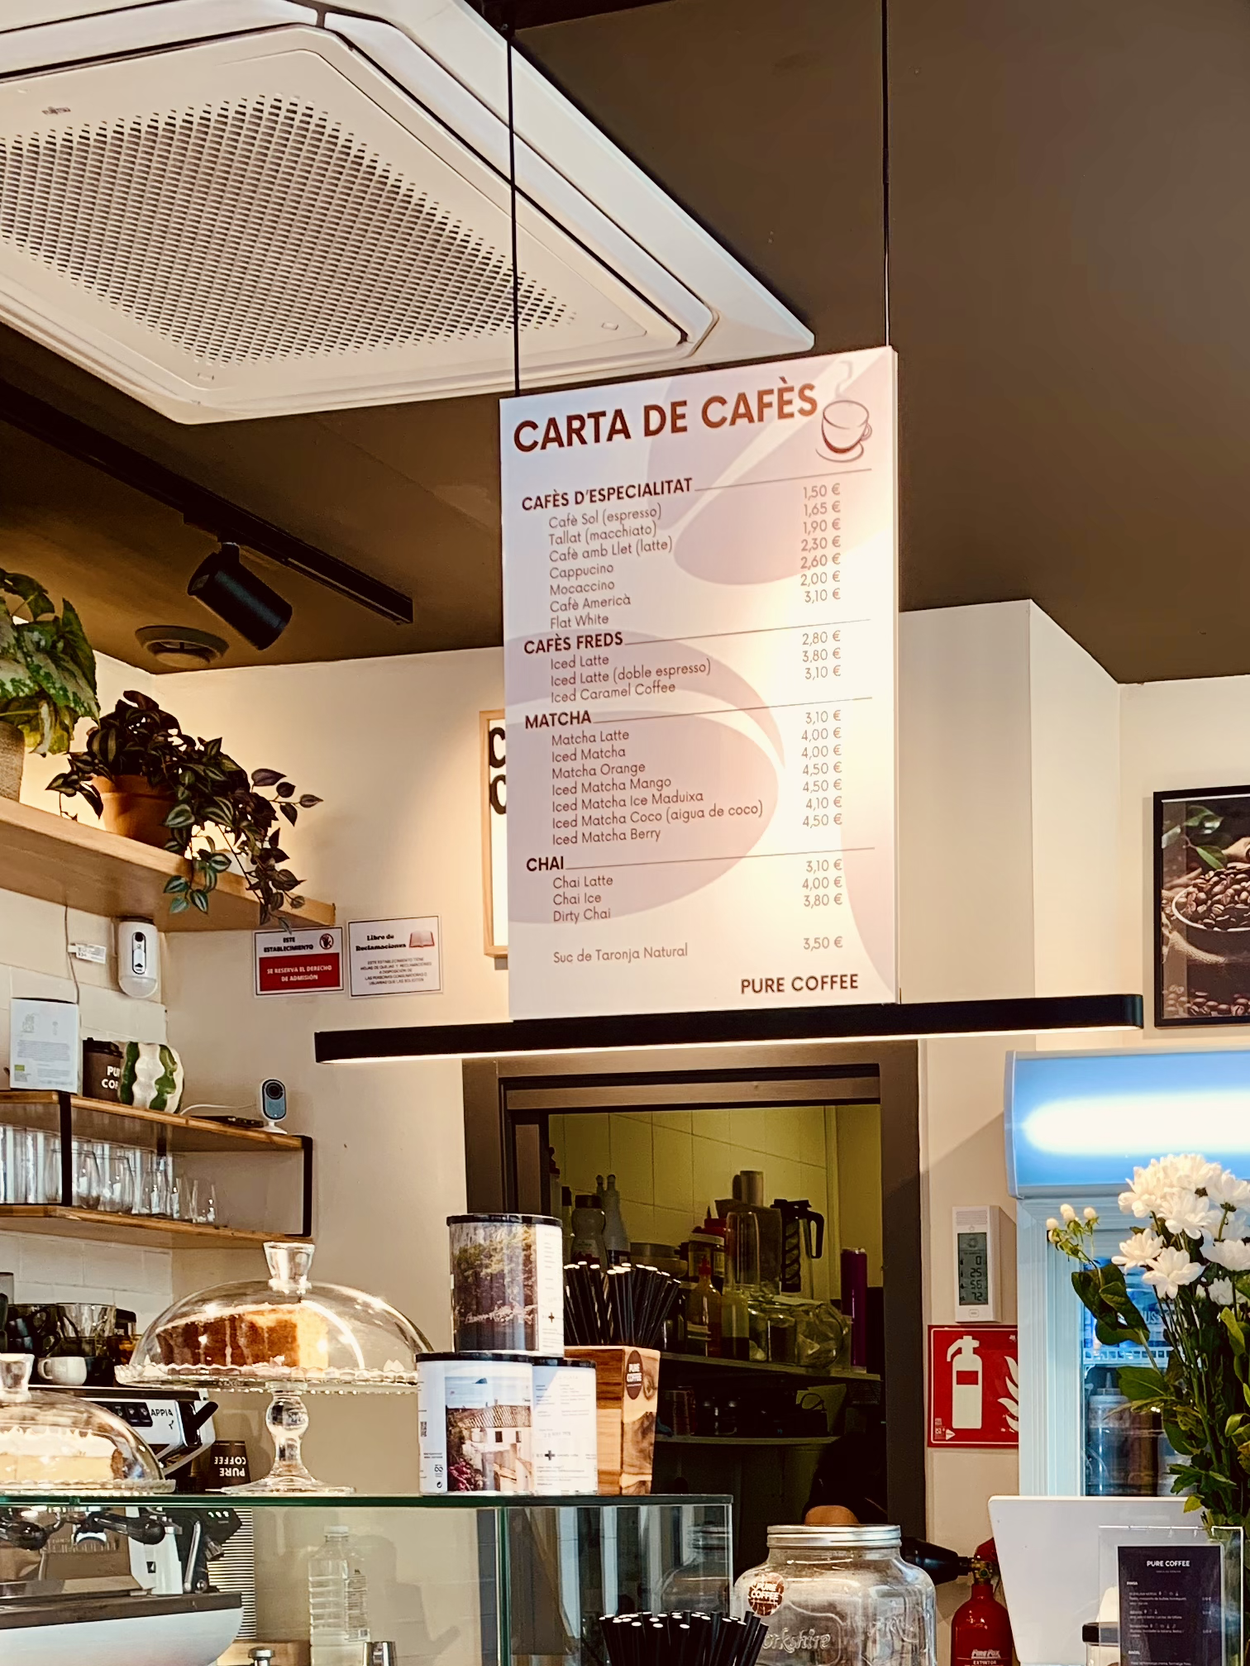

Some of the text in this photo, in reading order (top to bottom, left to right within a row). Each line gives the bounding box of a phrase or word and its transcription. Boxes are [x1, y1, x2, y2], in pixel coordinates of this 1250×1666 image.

[513, 376, 818, 453] CARTA DE CAFÈS
[521, 477, 693, 511] CAFÈS D'ESPECIALITAT
[803, 482, 841, 501] 1,50 €
[548, 502, 662, 529] Cafè Sol (espresso)
[803, 500, 841, 518] 1,65 €
[548, 520, 657, 546] Tallat (macchiato)
[803, 517, 841, 536] 1,90 €
[549, 535, 673, 563] Cafè amb Llet (latte)
[801, 535, 841, 553] 2,30 €
[800, 552, 841, 571] 2,60 €
[549, 563, 614, 581] Cappucino
[800, 570, 841, 588] 2,00 €
[549, 579, 615, 596] Mocaccino
[804, 587, 841, 604] 3,10 €
[550, 593, 631, 613] Cafè Americà
[550, 612, 609, 629] Flat White
[524, 631, 624, 655] CAFÈS FREDS
[802, 630, 841, 647] 2,80 €
[550, 654, 609, 670] Iced Latte
[802, 647, 841, 663] 3,80 €
[550, 658, 711, 687] Iced Latte (doble espresso)
[804, 664, 841, 681] 3,10 €
[551, 679, 676, 703] Iced Caramel Coffee
[525, 709, 592, 730] MATCHA
[805, 709, 842, 725] 3,10 €
[551, 730, 630, 746] Matcha Latte
[801, 726, 842, 743] 4,00 €
[551, 744, 626, 763] Iced Matcha
[801, 743, 842, 760] 4,00 €
[552, 762, 646, 780] Matcha Orange
[802, 761, 842, 777] 4,50 €
[552, 777, 672, 796] Iced Matcha Mango
[802, 778, 842, 794] 4,50 €
[552, 789, 704, 813] Iced Matcha Ice Maduixa
[805, 795, 842, 812] 4,10 €
[552, 799, 763, 829] Iced Matcha Coco (aigua de coco)
[802, 813, 843, 829] 4,50 €
[552, 827, 661, 845] Iced Matcha Berry
[526, 856, 564, 872] CHAI
[806, 858, 843, 875] 3,10 €
[553, 875, 614, 890] Chai Latte
[802, 875, 843, 892] 4,00 €
[553, 891, 602, 906] Chai Ice
[803, 893, 843, 909] 3,80 €
[553, 906, 611, 925] Dirty Chai
[553, 942, 688, 964] Suc de Taronja Natural
[803, 936, 843, 952] 3,50 €
[740, 973, 859, 994] PURE COFFEE
[151, 1409, 174, 1417] APPIA
[219, 1467, 246, 1477] PURE
[762, 1627, 831, 1654] orkshire
